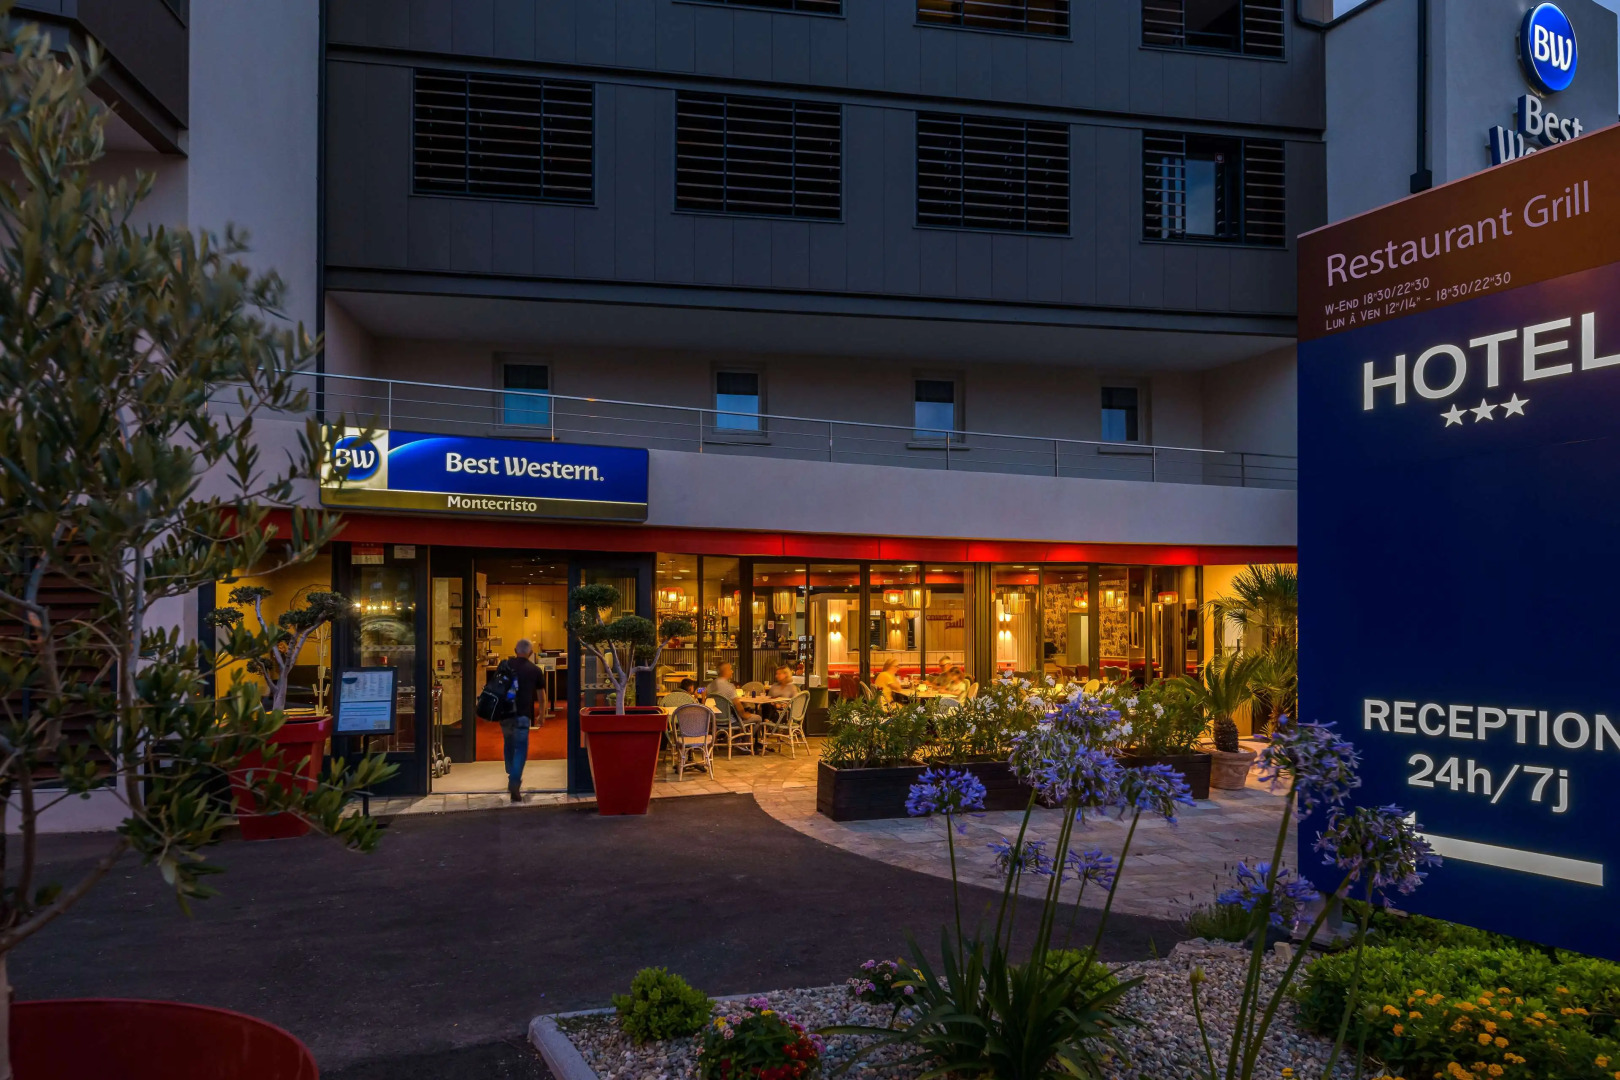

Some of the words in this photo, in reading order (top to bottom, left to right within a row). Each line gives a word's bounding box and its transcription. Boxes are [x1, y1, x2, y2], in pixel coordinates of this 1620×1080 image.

[1534, 24, 1573, 72] BW
[1525, 94, 1584, 144] Best
[1326, 207, 1513, 287] Restaurant
[1523, 180, 1590, 228] Grill
[1363, 311, 1620, 411] HOTEL
[335, 448, 375, 469] BW
[445, 452, 500, 476] Best
[447, 495, 538, 513] Montecristo
[1363, 699, 1620, 751] RECEPTION
[1407, 753, 1569, 813] 24h/7j
